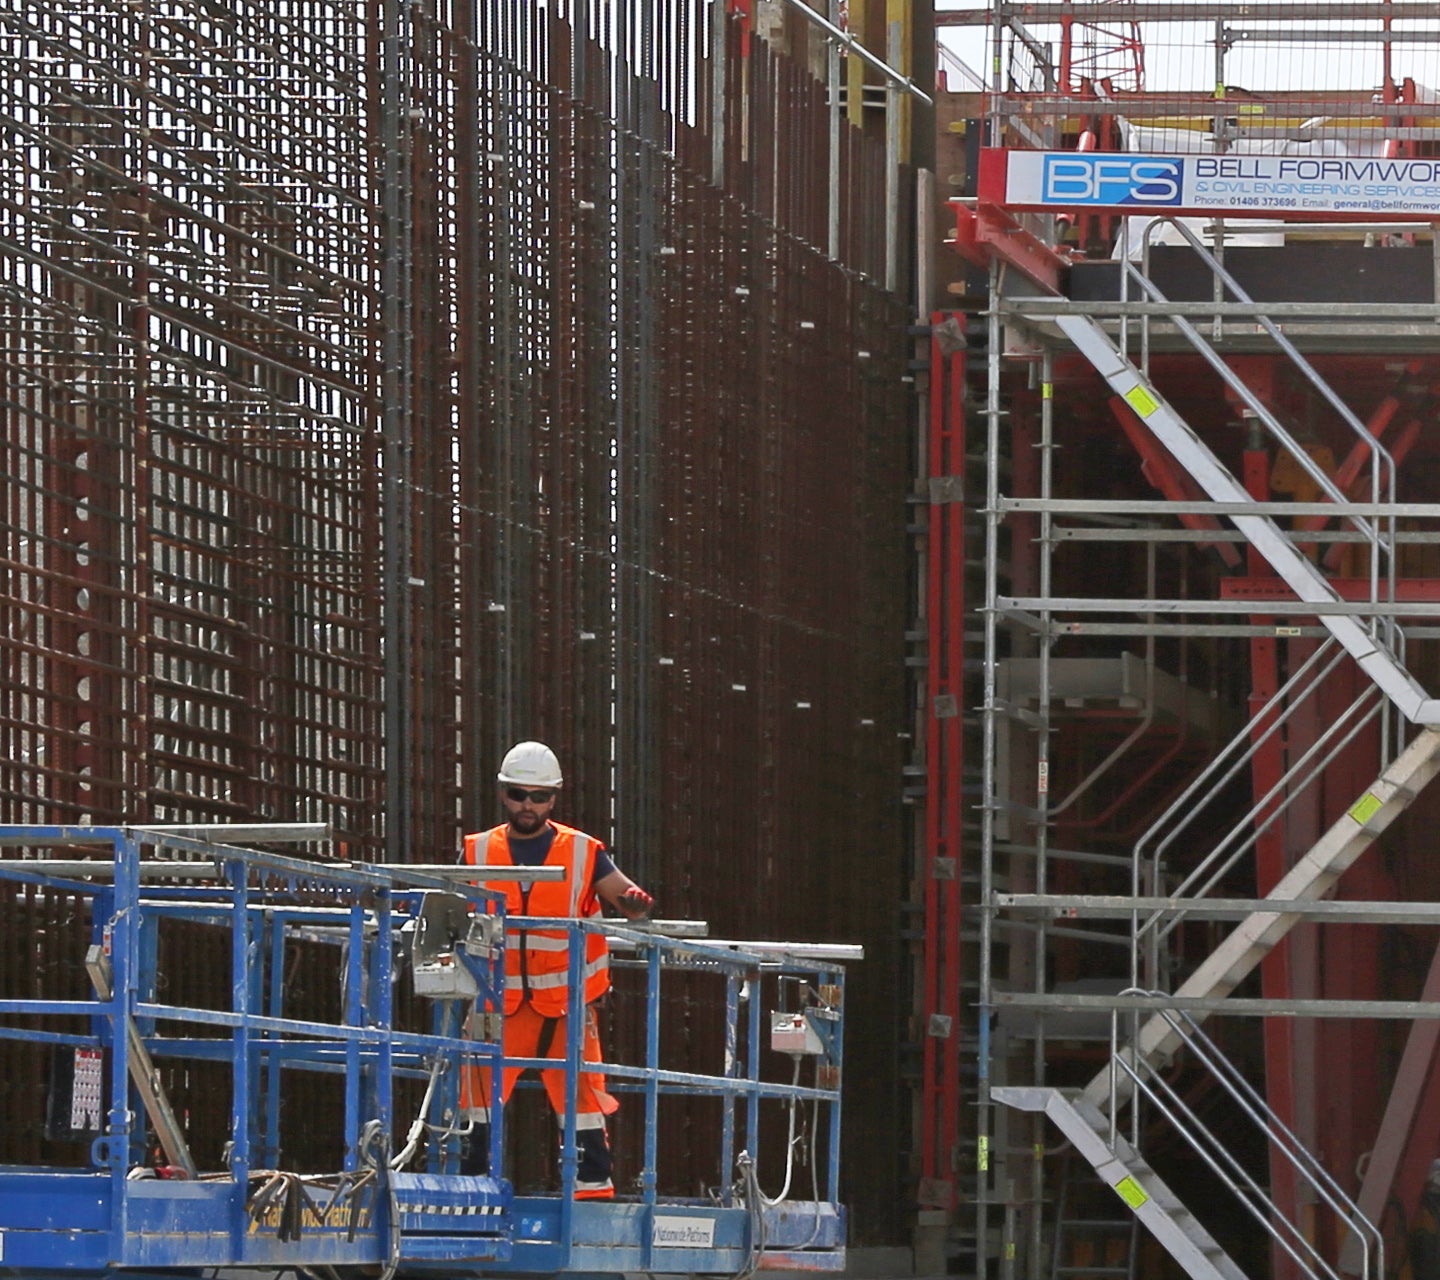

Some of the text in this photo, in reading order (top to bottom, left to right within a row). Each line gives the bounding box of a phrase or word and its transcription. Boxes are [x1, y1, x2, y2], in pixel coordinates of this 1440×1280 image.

[1196, 158, 1274, 180] BELL
[1046, 159, 1180, 202] BFS
[1196, 183, 1209, 193] &
[1210, 183, 1257, 195] CIVIL
[1260, 184, 1360, 197] ENGINEERING
[1194, 195, 1227, 207] Phone:
[1229, 196, 1260, 207] 01406
[1262, 197, 1297, 208] 373696
[1302, 198, 1331, 209] Email:
